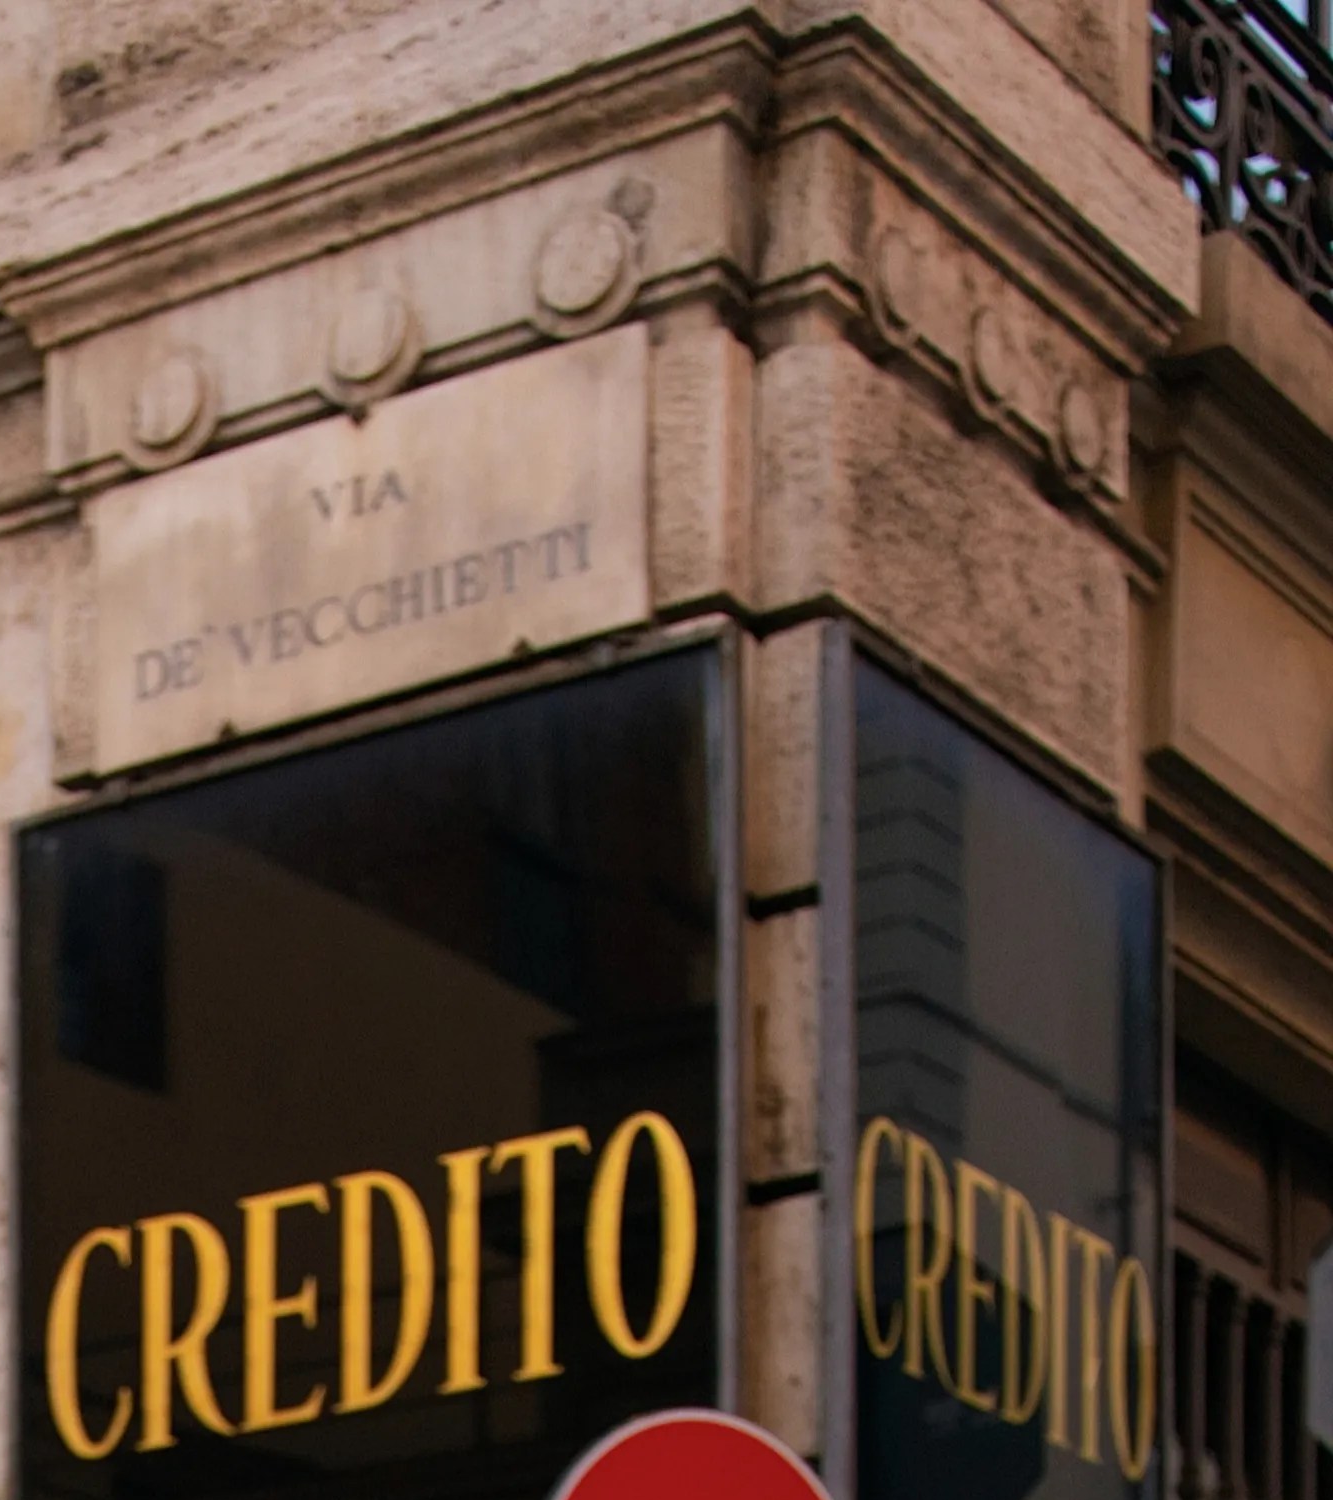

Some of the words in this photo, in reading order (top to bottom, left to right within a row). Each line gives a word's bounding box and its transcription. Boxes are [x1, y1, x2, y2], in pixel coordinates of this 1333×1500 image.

[224, 522, 595, 673] VECCHIETTI
[310, 468, 411, 524] VIA
[46, 1109, 698, 1460] CREDITO
[855, 1115, 1157, 1481] CREDITO
